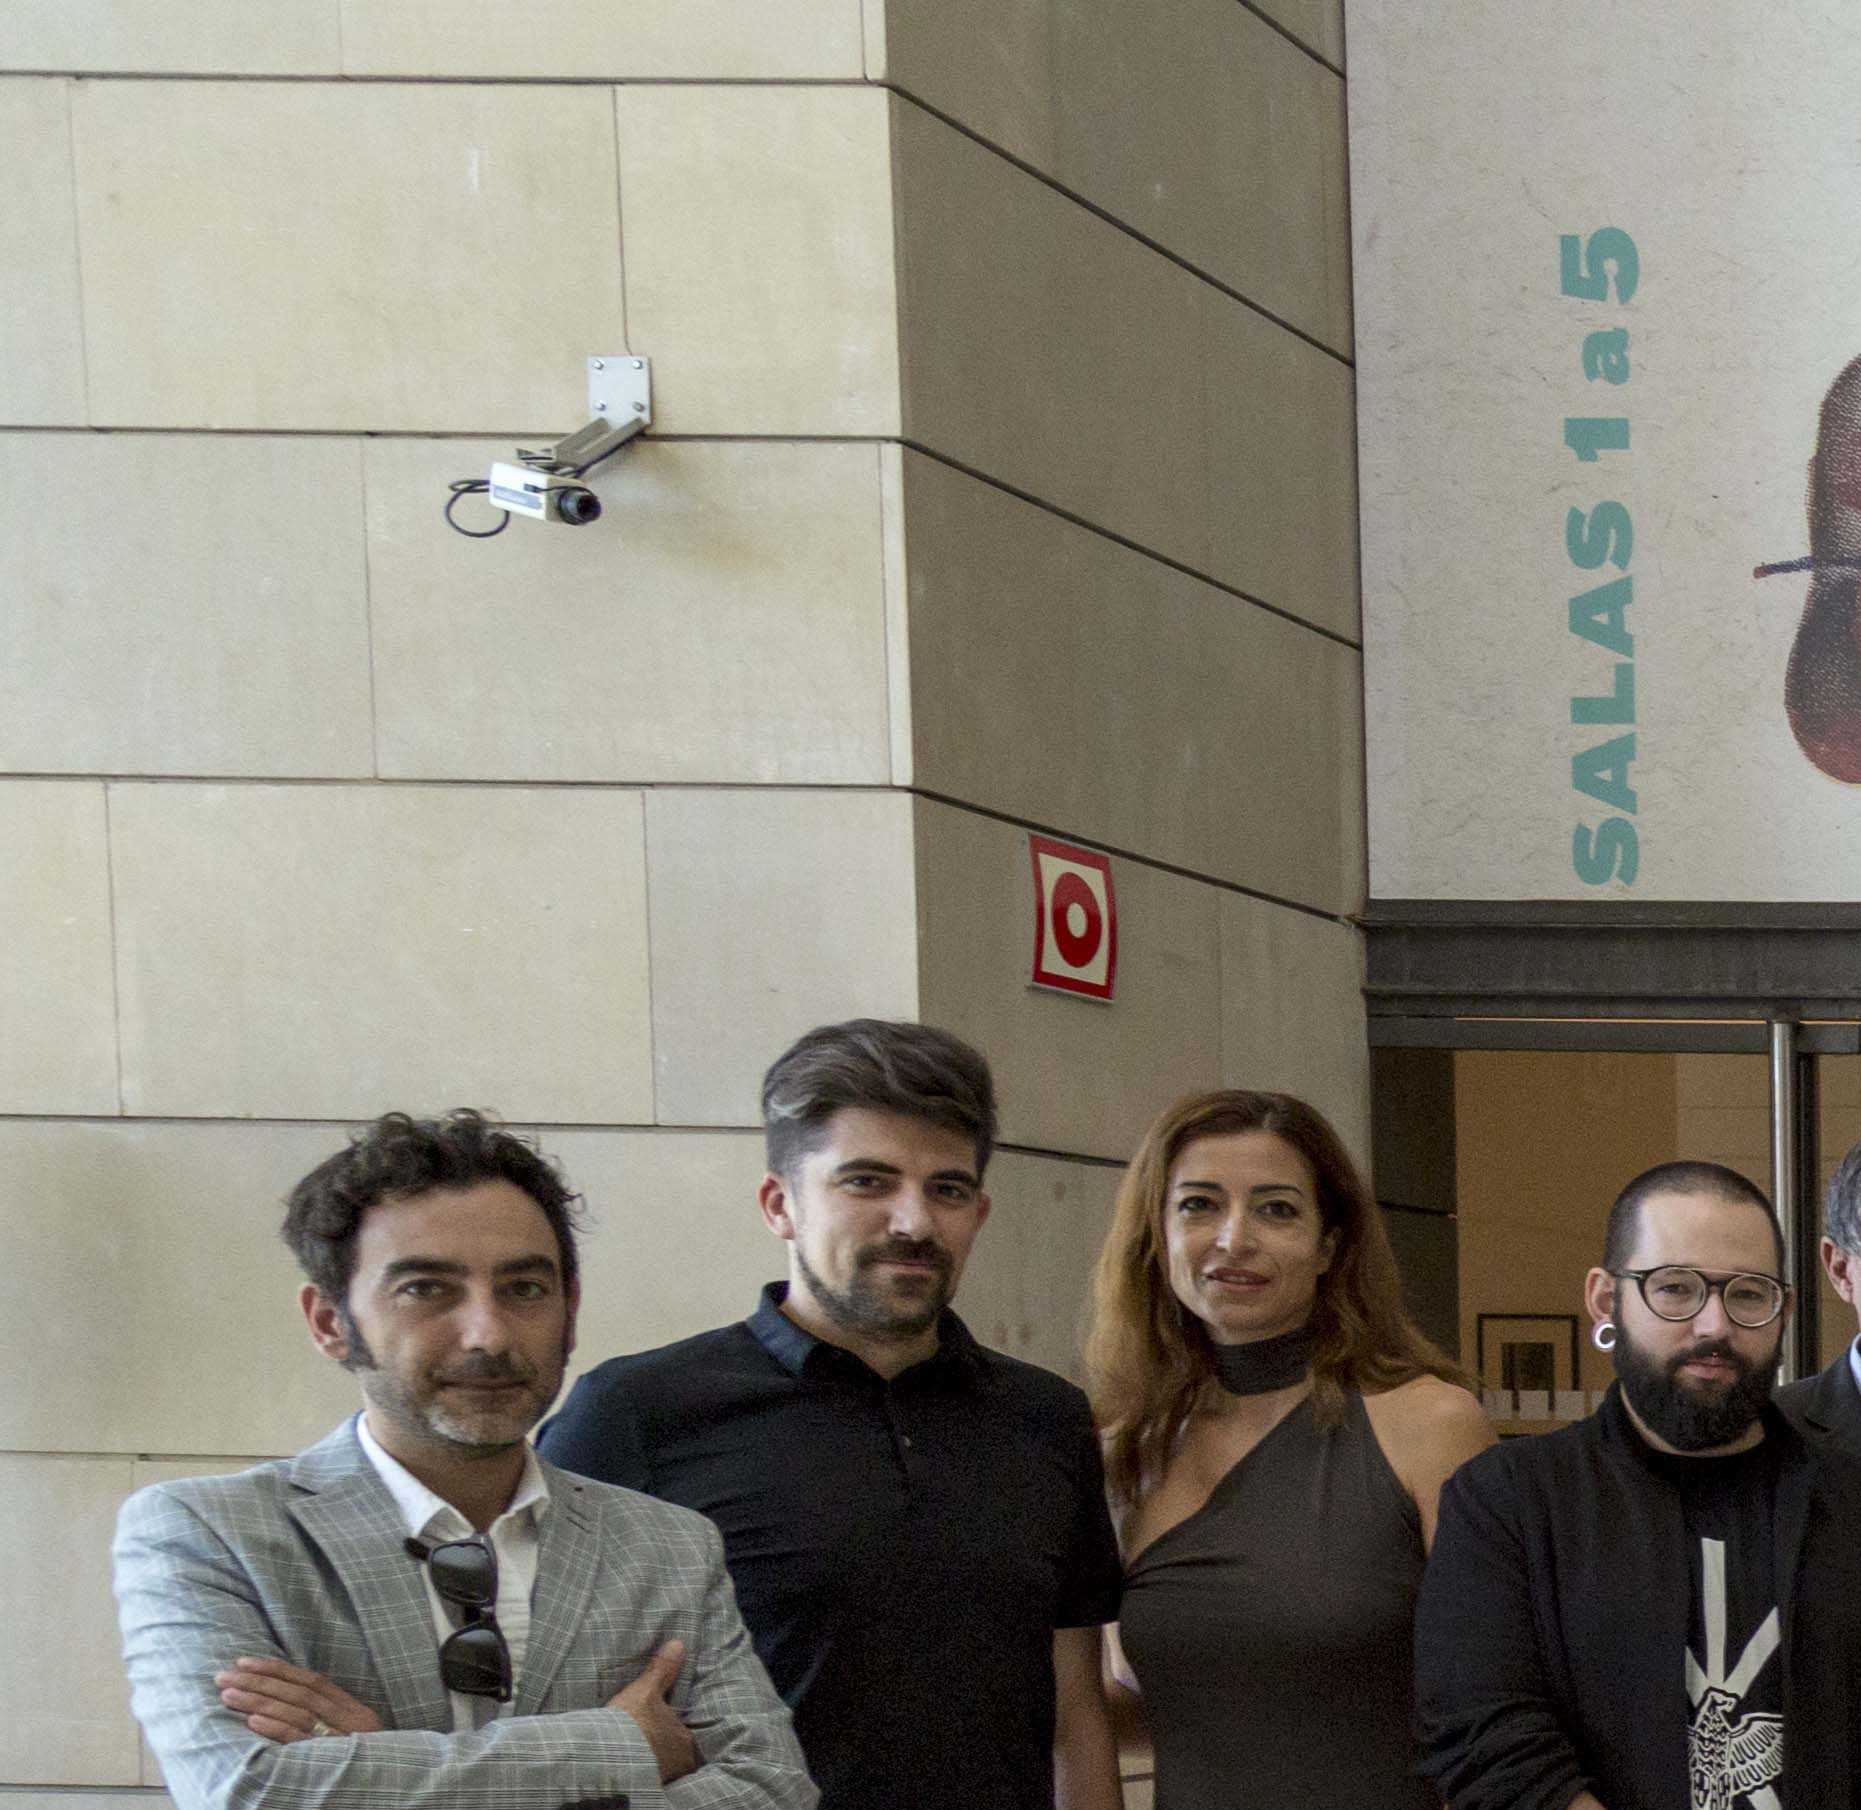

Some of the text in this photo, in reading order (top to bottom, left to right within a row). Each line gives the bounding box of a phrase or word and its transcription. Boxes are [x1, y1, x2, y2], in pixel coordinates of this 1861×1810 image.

[1559, 225, 1641, 888] SALAS 1 a 5
